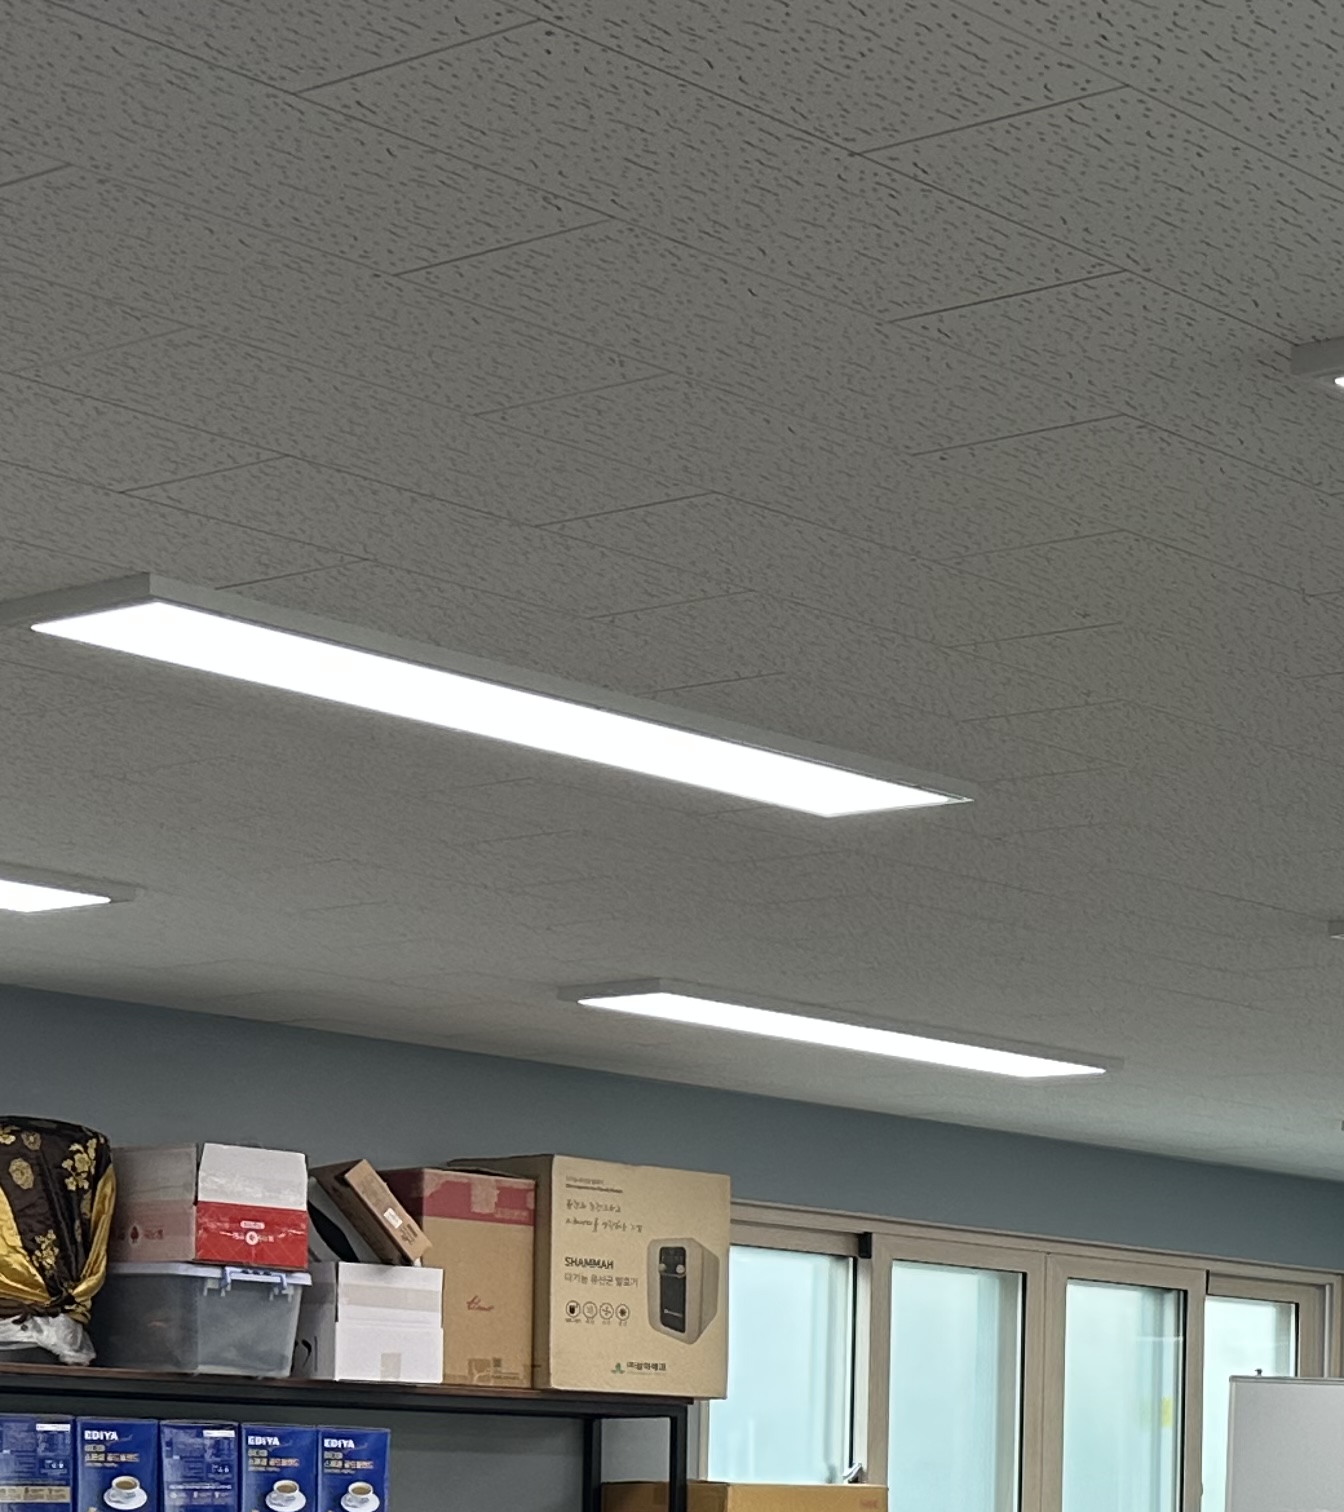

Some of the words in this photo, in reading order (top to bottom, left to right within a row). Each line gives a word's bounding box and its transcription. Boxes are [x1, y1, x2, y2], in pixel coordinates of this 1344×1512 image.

[84, 1430, 119, 1441] EDIYA
[247, 1435, 280, 1446] EDIYA
[323, 1438, 355, 1449] EDIYA
